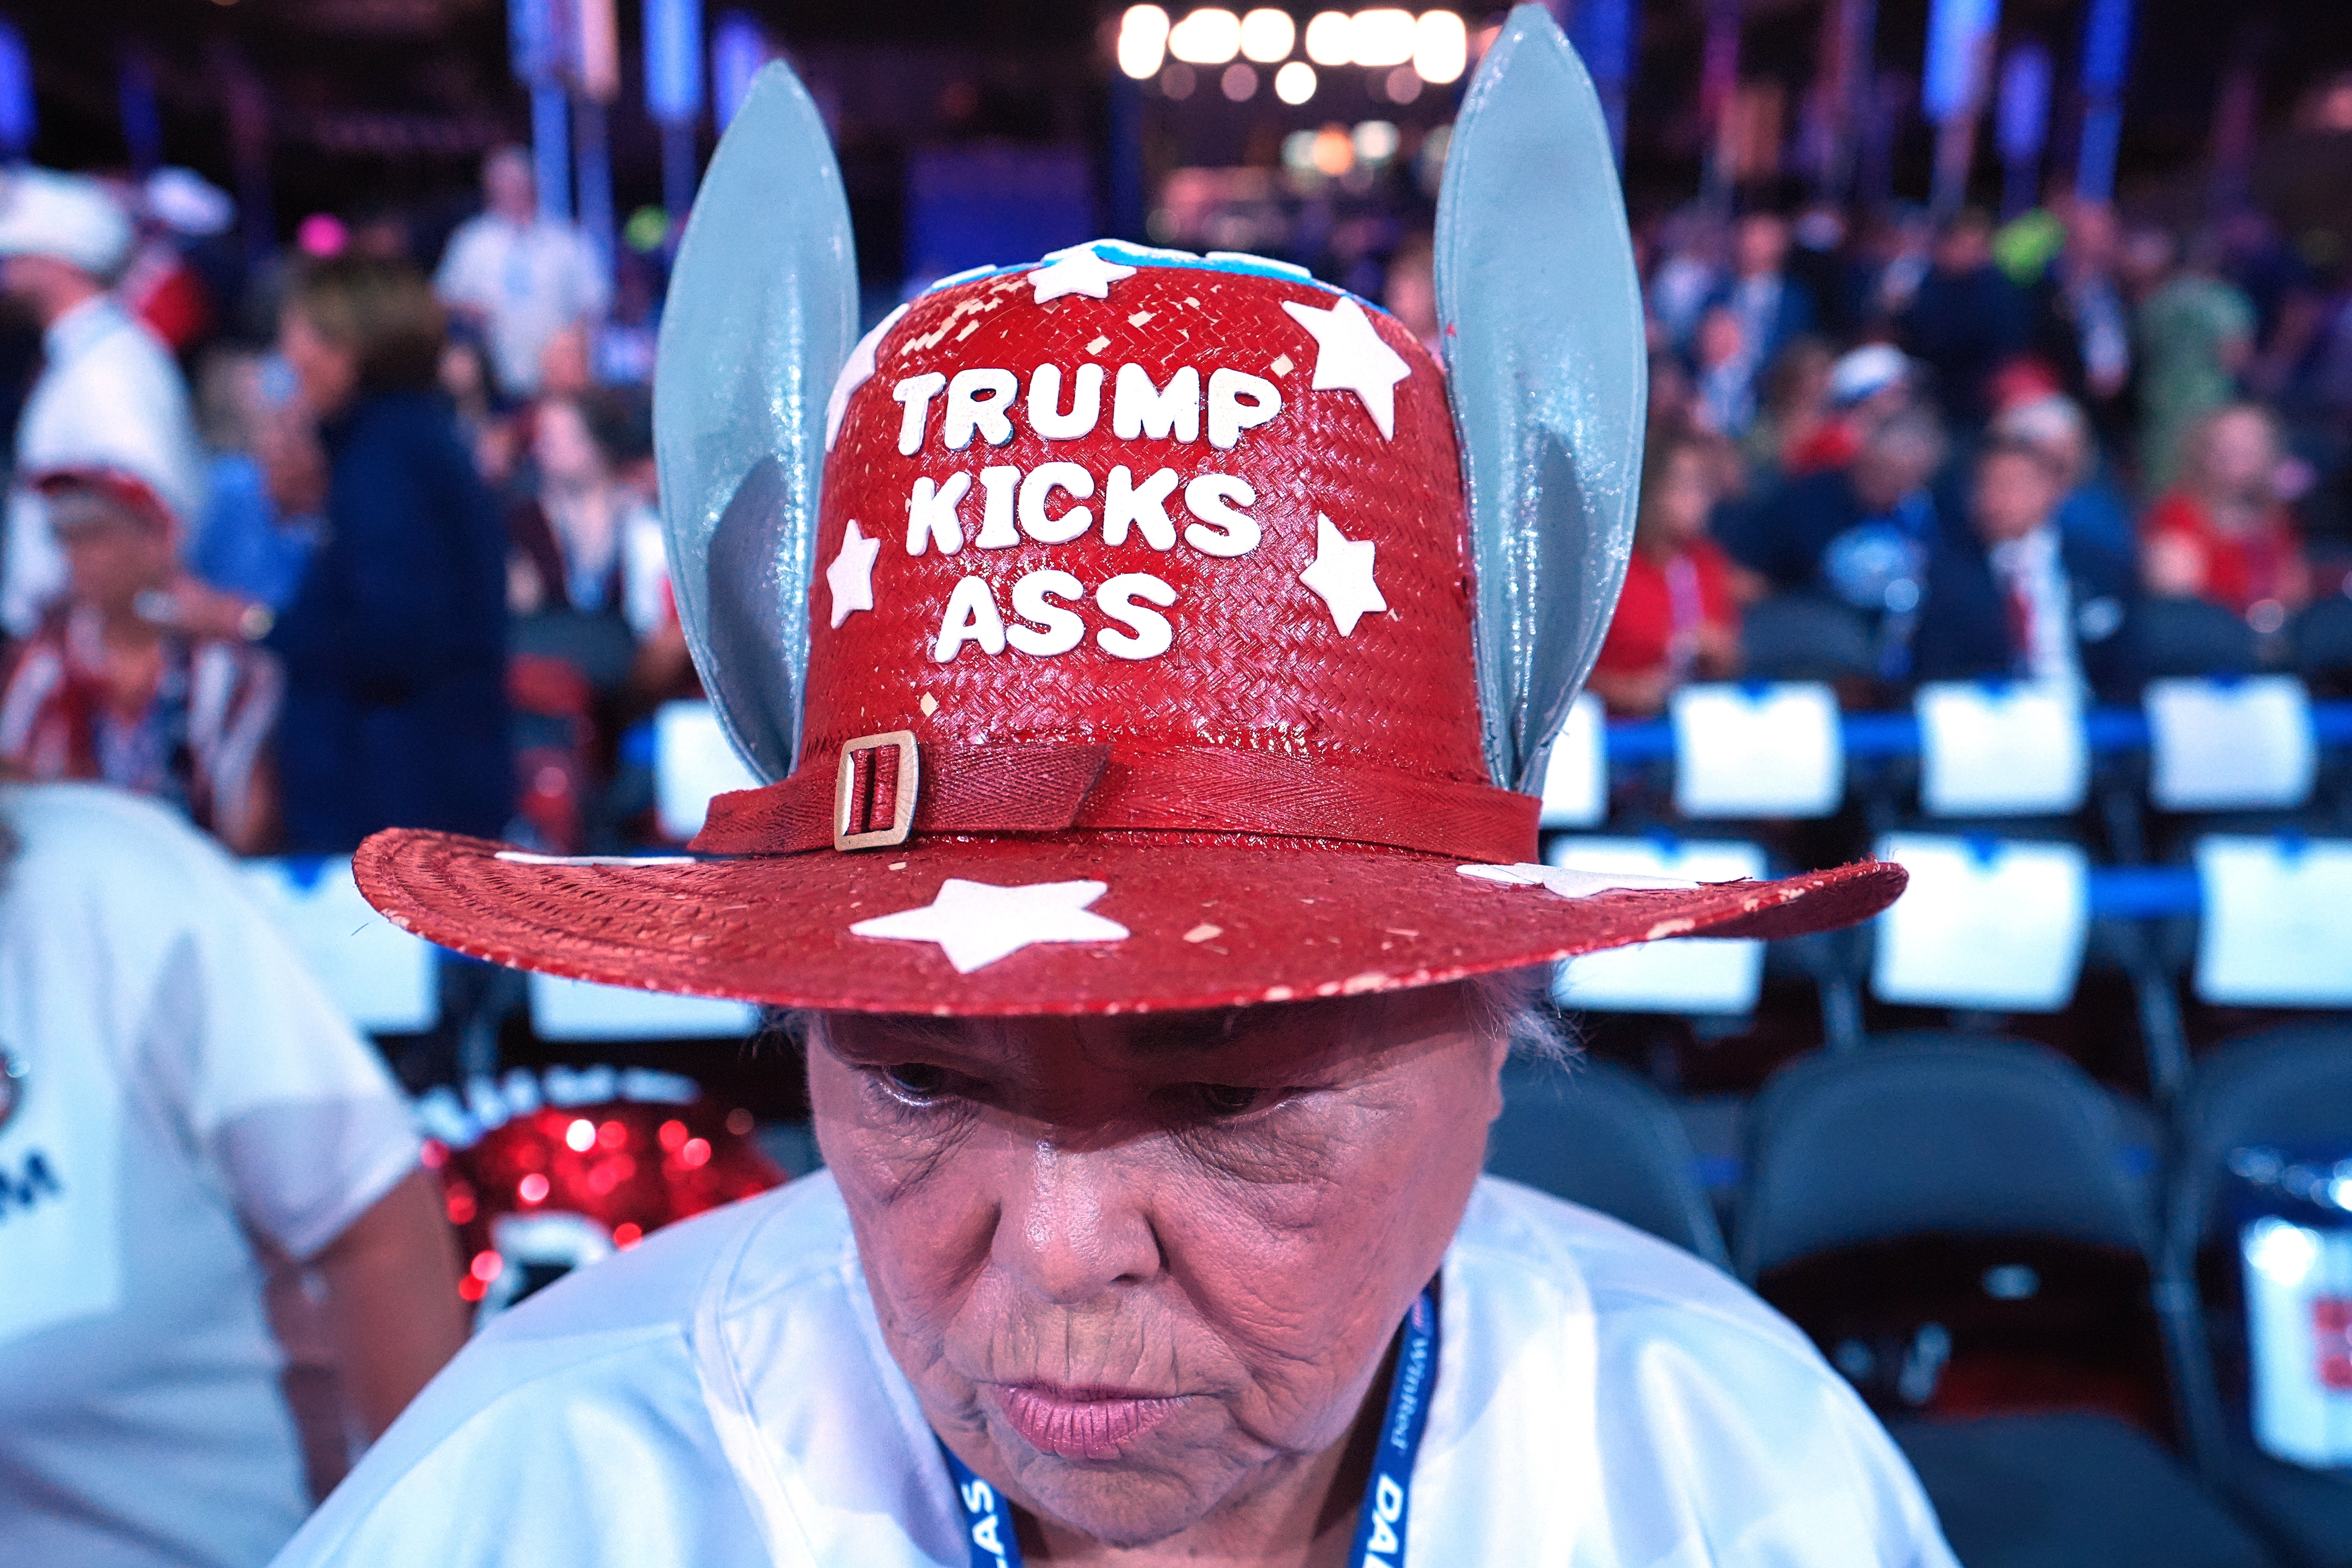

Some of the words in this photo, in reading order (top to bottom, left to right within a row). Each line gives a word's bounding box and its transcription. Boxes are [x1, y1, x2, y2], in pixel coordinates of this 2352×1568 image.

[893, 363, 1283, 456] TRUMP
[905, 461, 1263, 556] KICKS
[933, 569, 1177, 663] ASS
[960, 1479, 1009, 1568] AS
